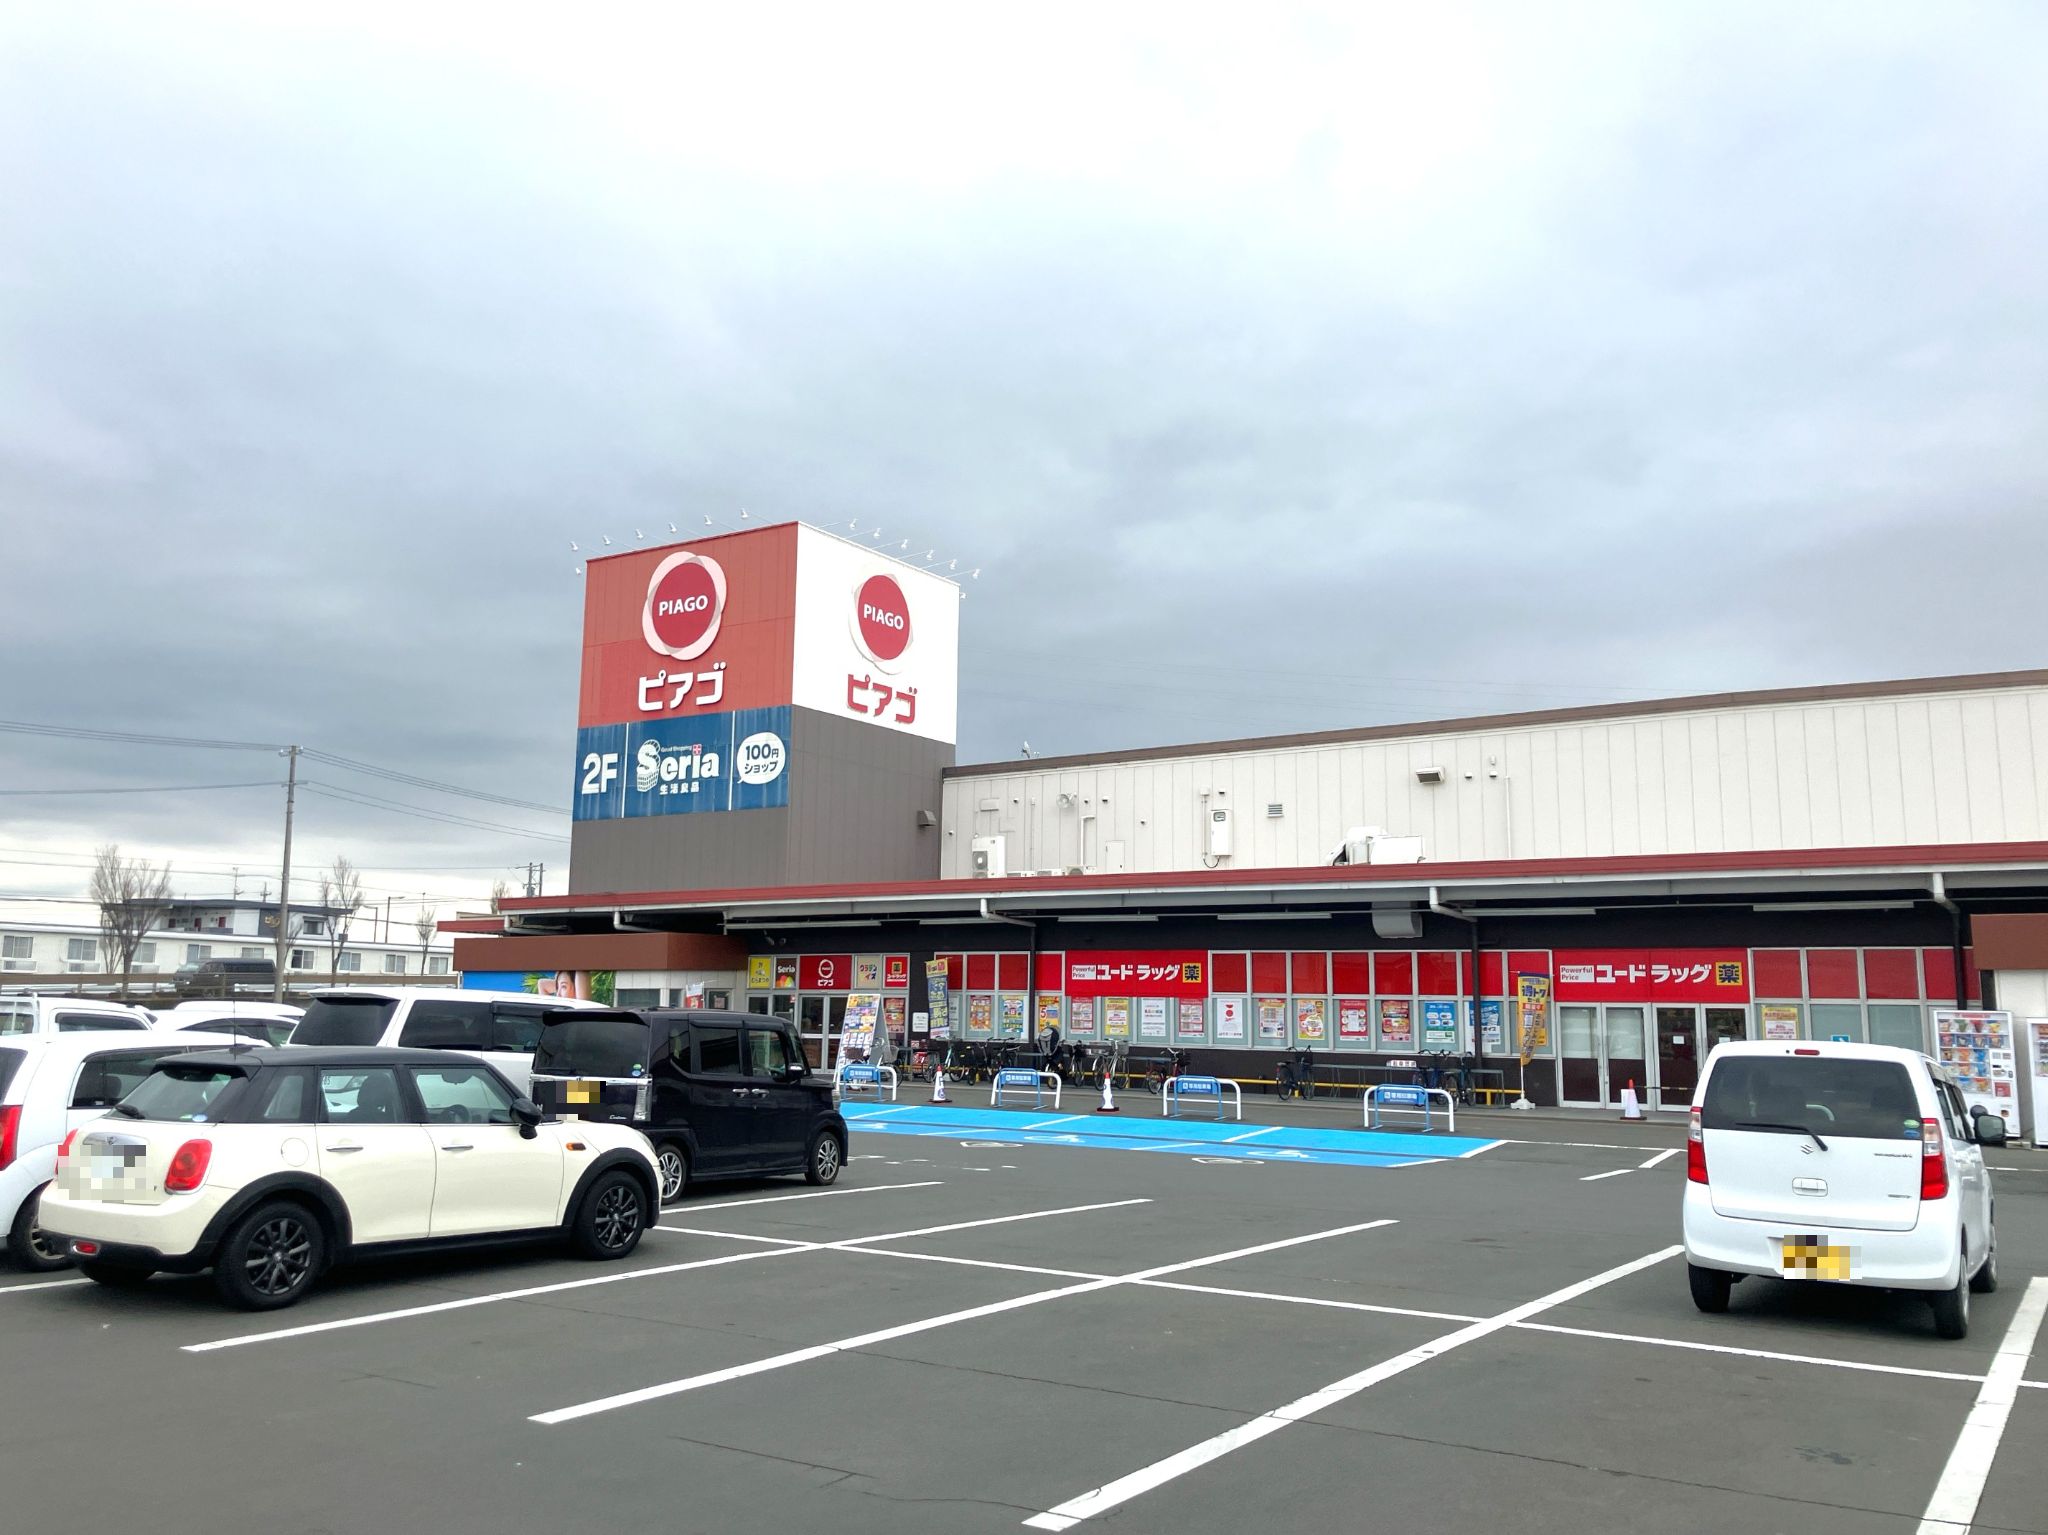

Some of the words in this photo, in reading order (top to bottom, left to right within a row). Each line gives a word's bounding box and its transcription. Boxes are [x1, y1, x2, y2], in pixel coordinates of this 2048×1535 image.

[658, 594, 708, 616] PIAGO
[863, 603, 904, 630] PIAGO
[638, 662, 726, 711] ピアゴ
[847, 674, 917, 724] ピアゴ
[745, 743, 779, 761] 100円
[581, 752, 618, 795] 2F
[636, 739, 720, 793] Seria
[744, 760, 779, 775] ショップ
[659, 781, 700, 796] 生活良品
[777, 964, 795, 974] Seria
[1719, 964, 1739, 983] 薬
